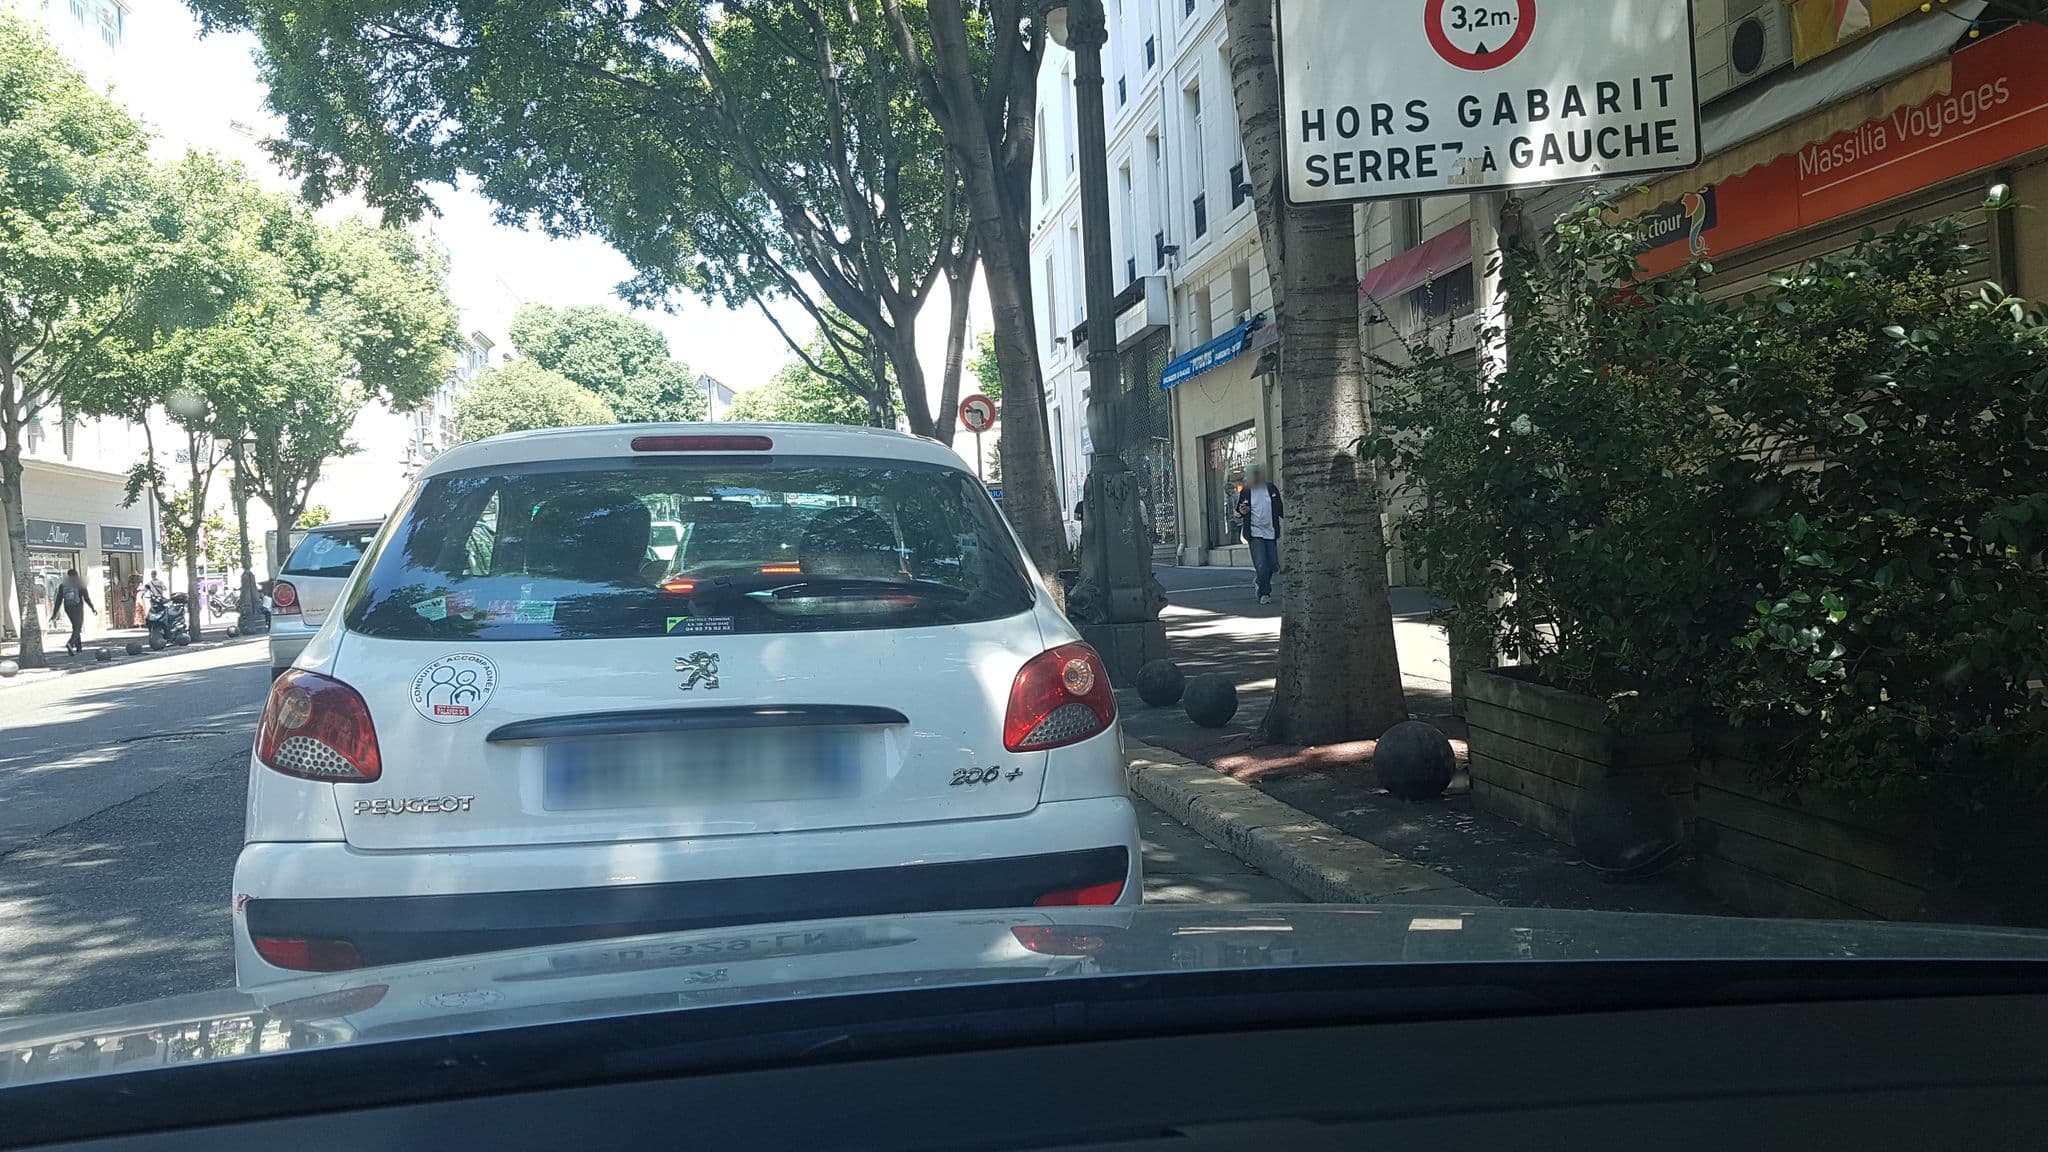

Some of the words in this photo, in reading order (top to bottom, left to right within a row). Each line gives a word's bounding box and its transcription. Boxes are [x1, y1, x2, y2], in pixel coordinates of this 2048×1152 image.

[1301, 99, 1431, 142] HORS
[1457, 74, 1674, 129] GABARIT
[1798, 124, 1888, 181] Massilia
[1891, 76, 2011, 143] Voyages
[1509, 119, 1680, 169] GAUCHE
[414, 661, 440, 703] CONDUITE
[352, 794, 475, 816] PEUGEOT
